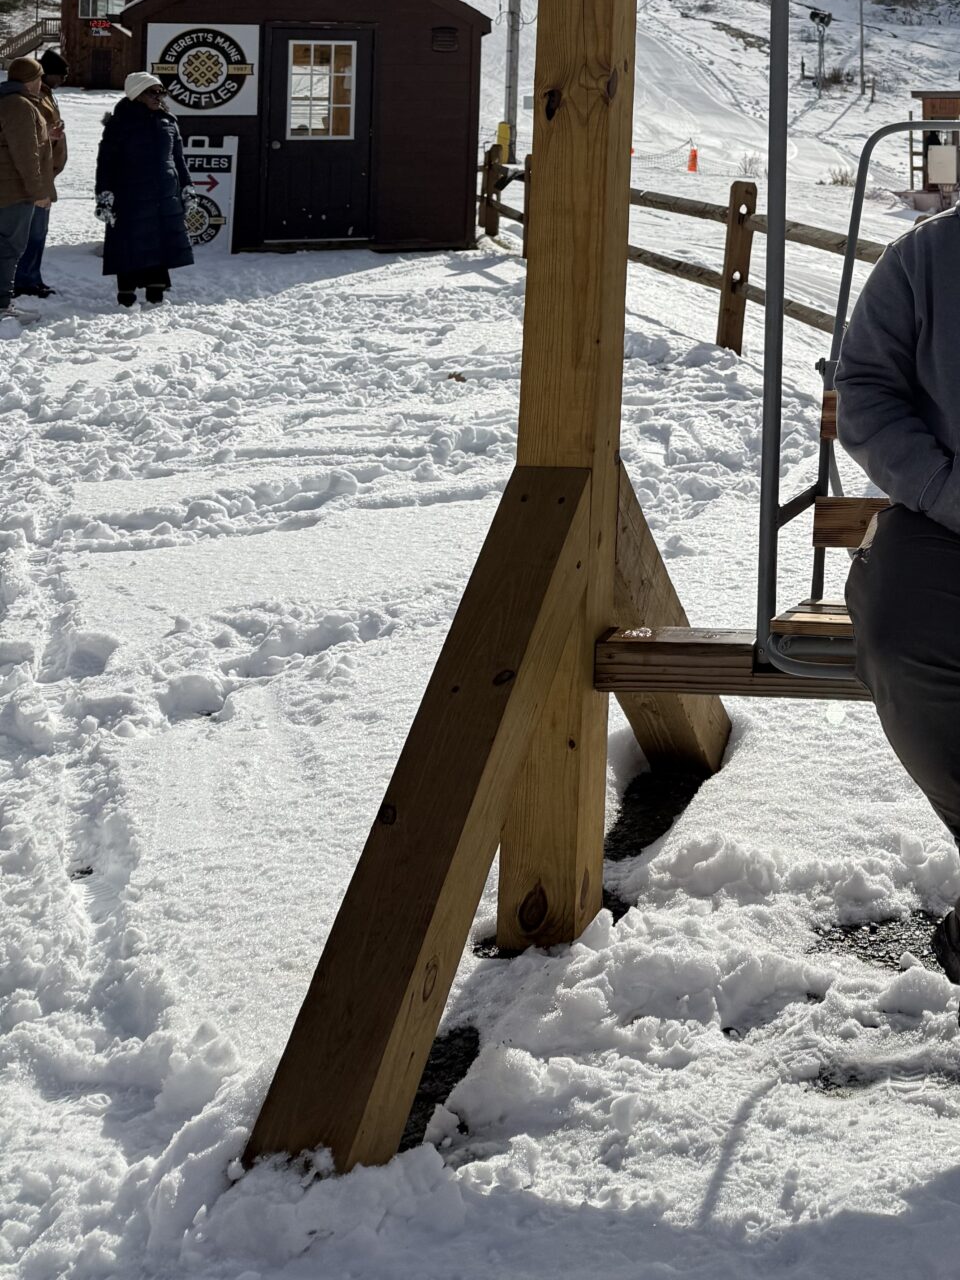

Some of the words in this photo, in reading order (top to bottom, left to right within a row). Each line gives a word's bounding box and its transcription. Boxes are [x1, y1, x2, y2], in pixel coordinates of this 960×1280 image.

[165, 33, 214, 62] EVERETT'S
[214, 36, 241, 62] MAINE
[168, 80, 238, 106] WAFFLES
[187, 157, 229, 169] FFLES
[191, 227, 216, 245] FLES
